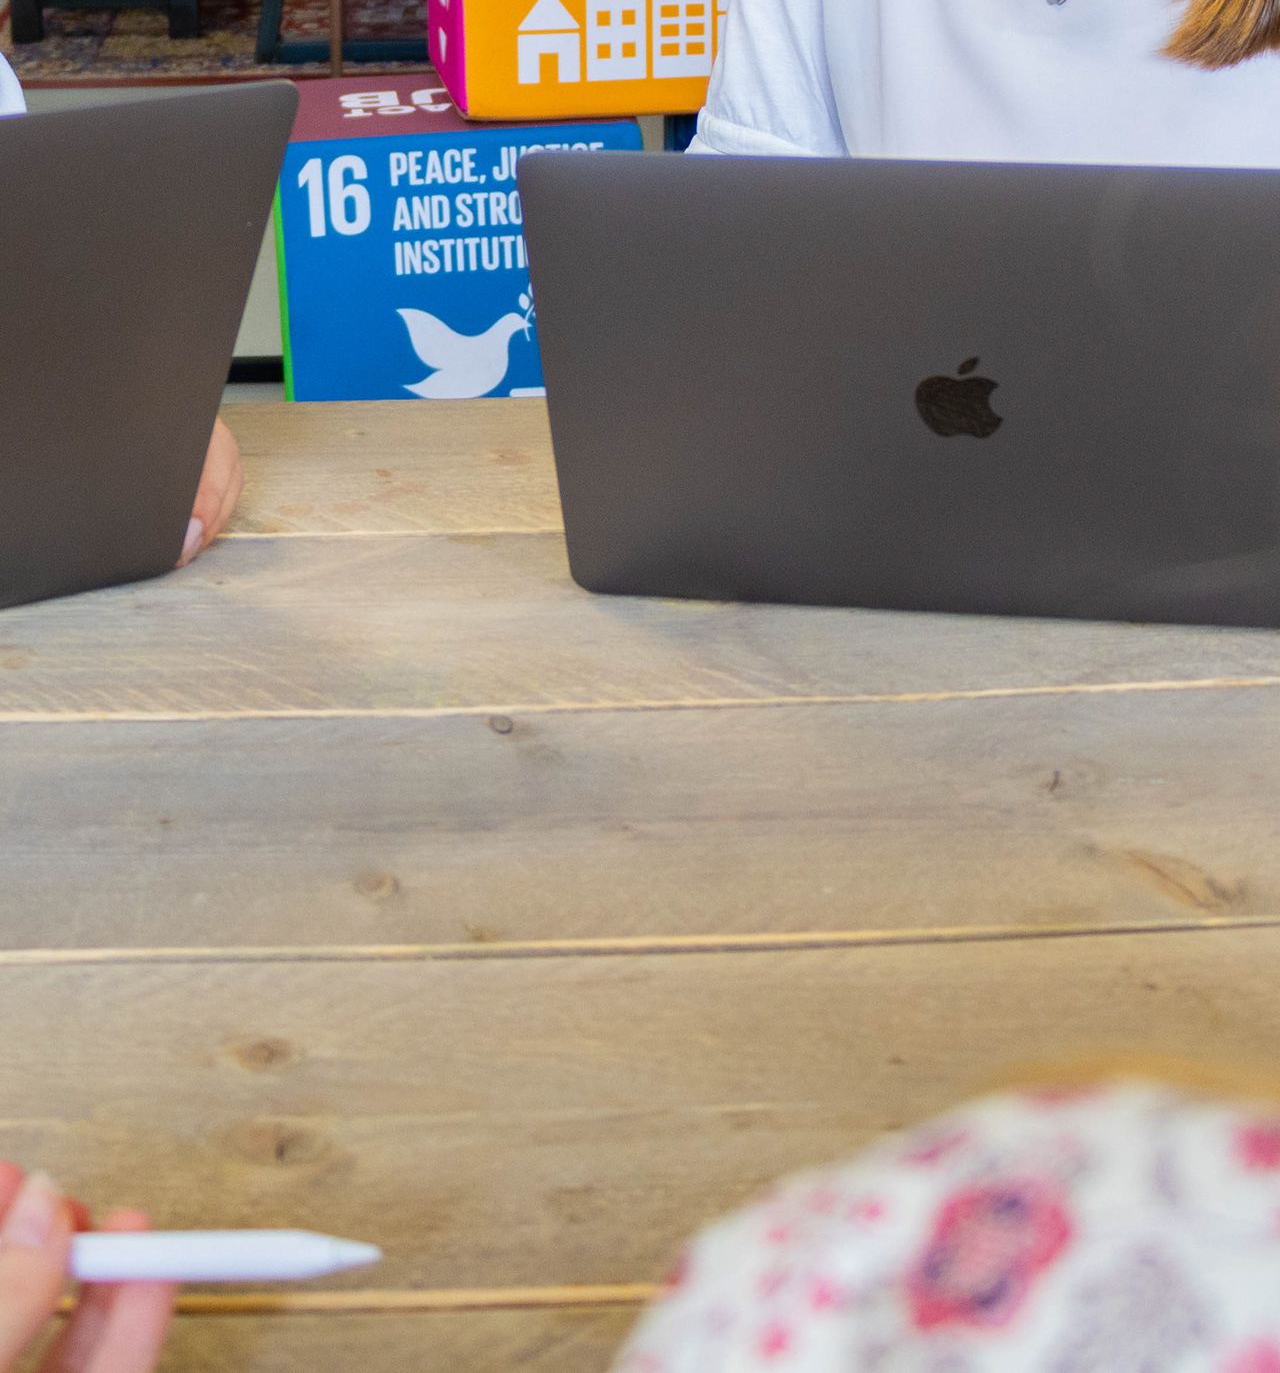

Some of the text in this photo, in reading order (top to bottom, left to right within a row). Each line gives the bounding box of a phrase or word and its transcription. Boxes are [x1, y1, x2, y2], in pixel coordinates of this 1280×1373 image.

[343, 102, 453, 118] ACT
[389, 148, 487, 187] PEACE,
[297, 154, 372, 238] 16
[393, 190, 522, 231] AND STRO
[394, 234, 529, 276] INSTITUTI
